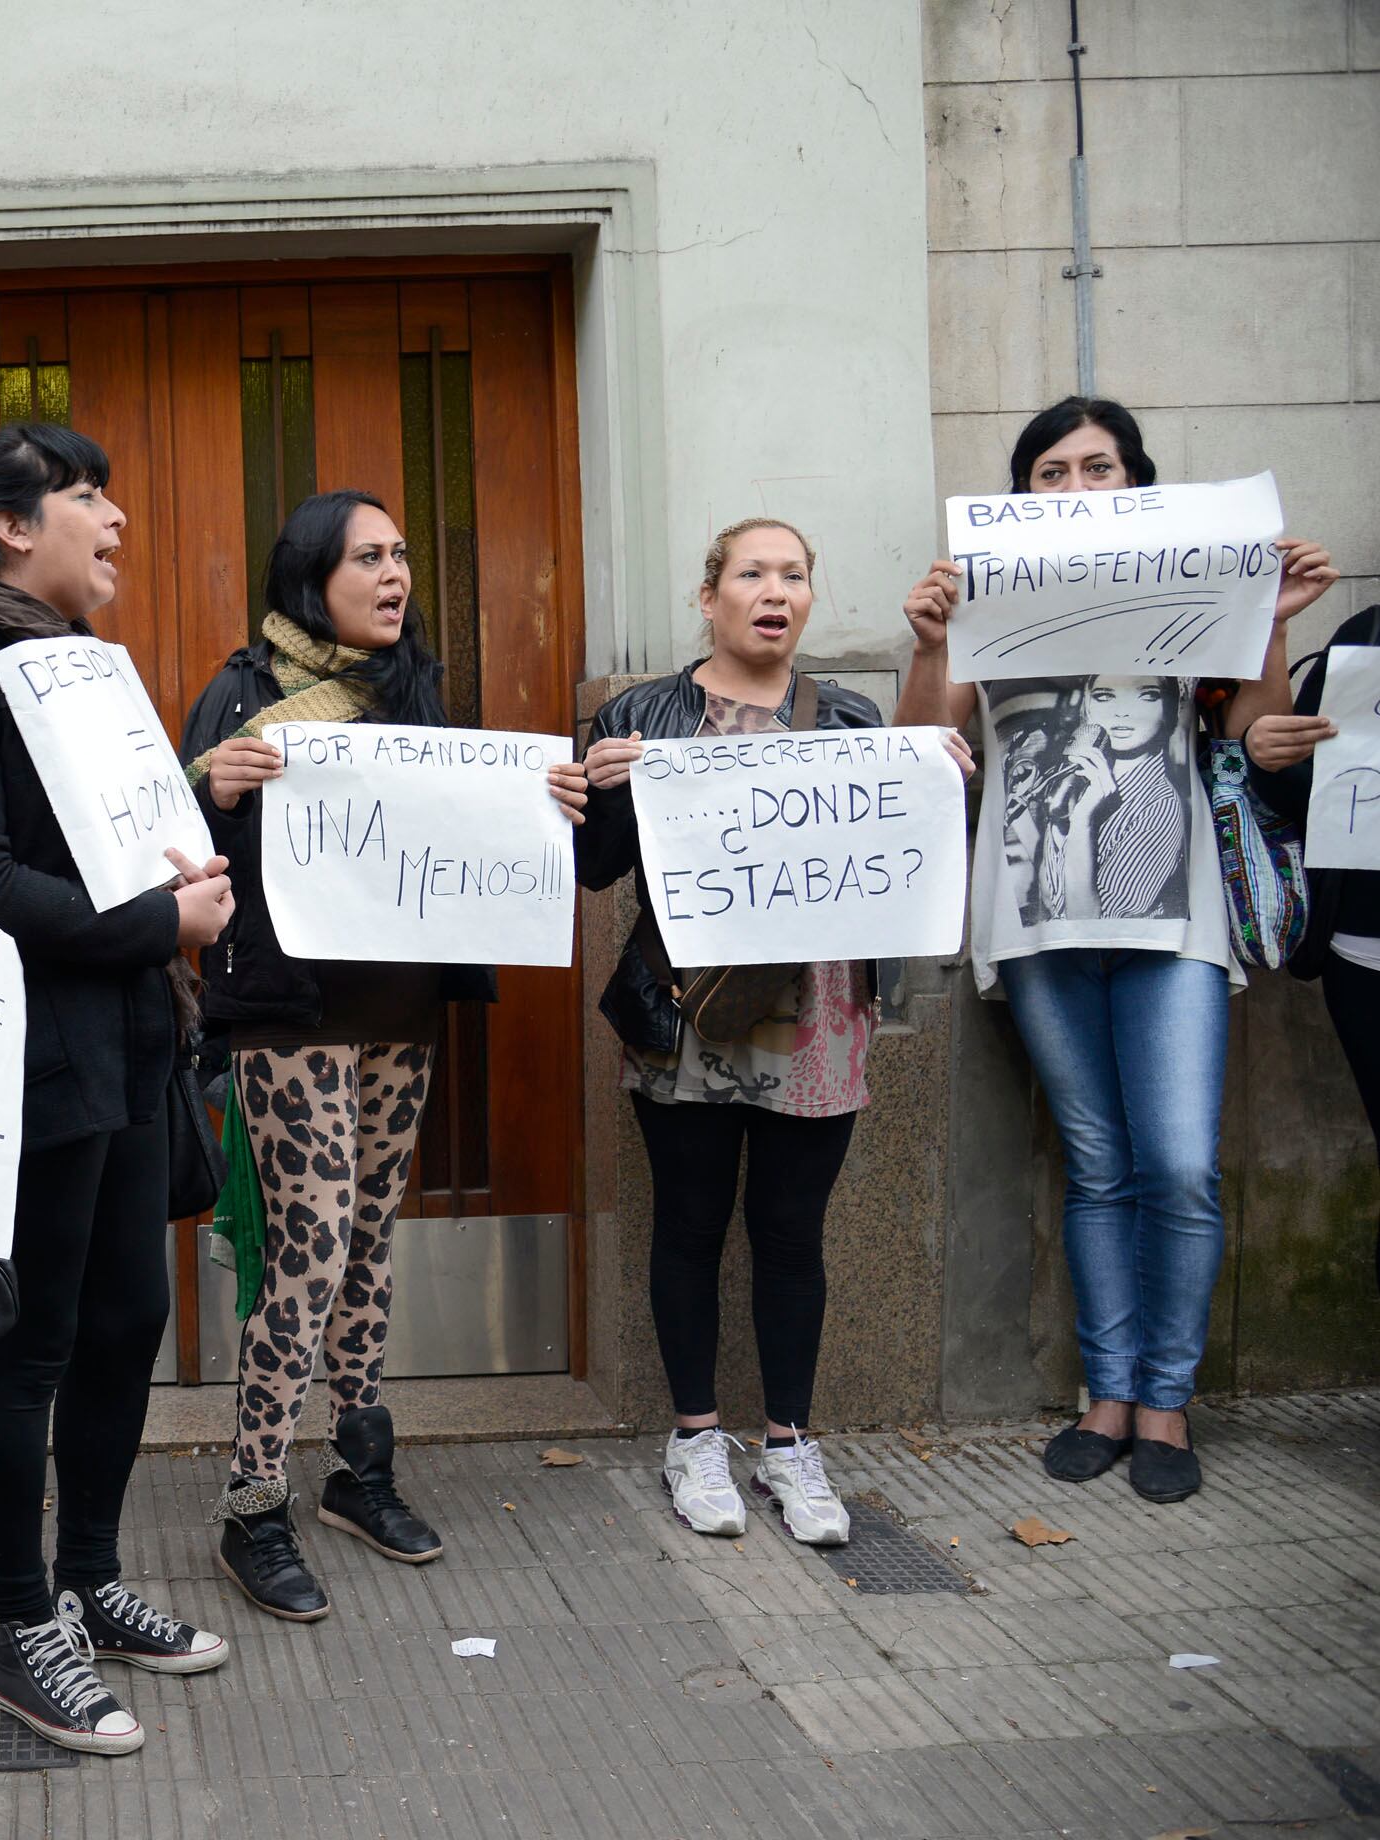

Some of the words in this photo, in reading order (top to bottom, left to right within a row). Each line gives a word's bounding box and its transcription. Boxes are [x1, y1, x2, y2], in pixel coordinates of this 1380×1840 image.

[968, 499, 1093, 528] BASTA
[1113, 491, 1165, 514] DE
[954, 542, 1279, 602] TRANSFEMICIDIOS
[272, 724, 353, 768] POR
[374, 735, 545, 772] ABANDONO
[644, 735, 920, 780] SUBSECRETARIA
[286, 798, 387, 867] UNA
[662, 848, 924, 921] ESTABAS?
